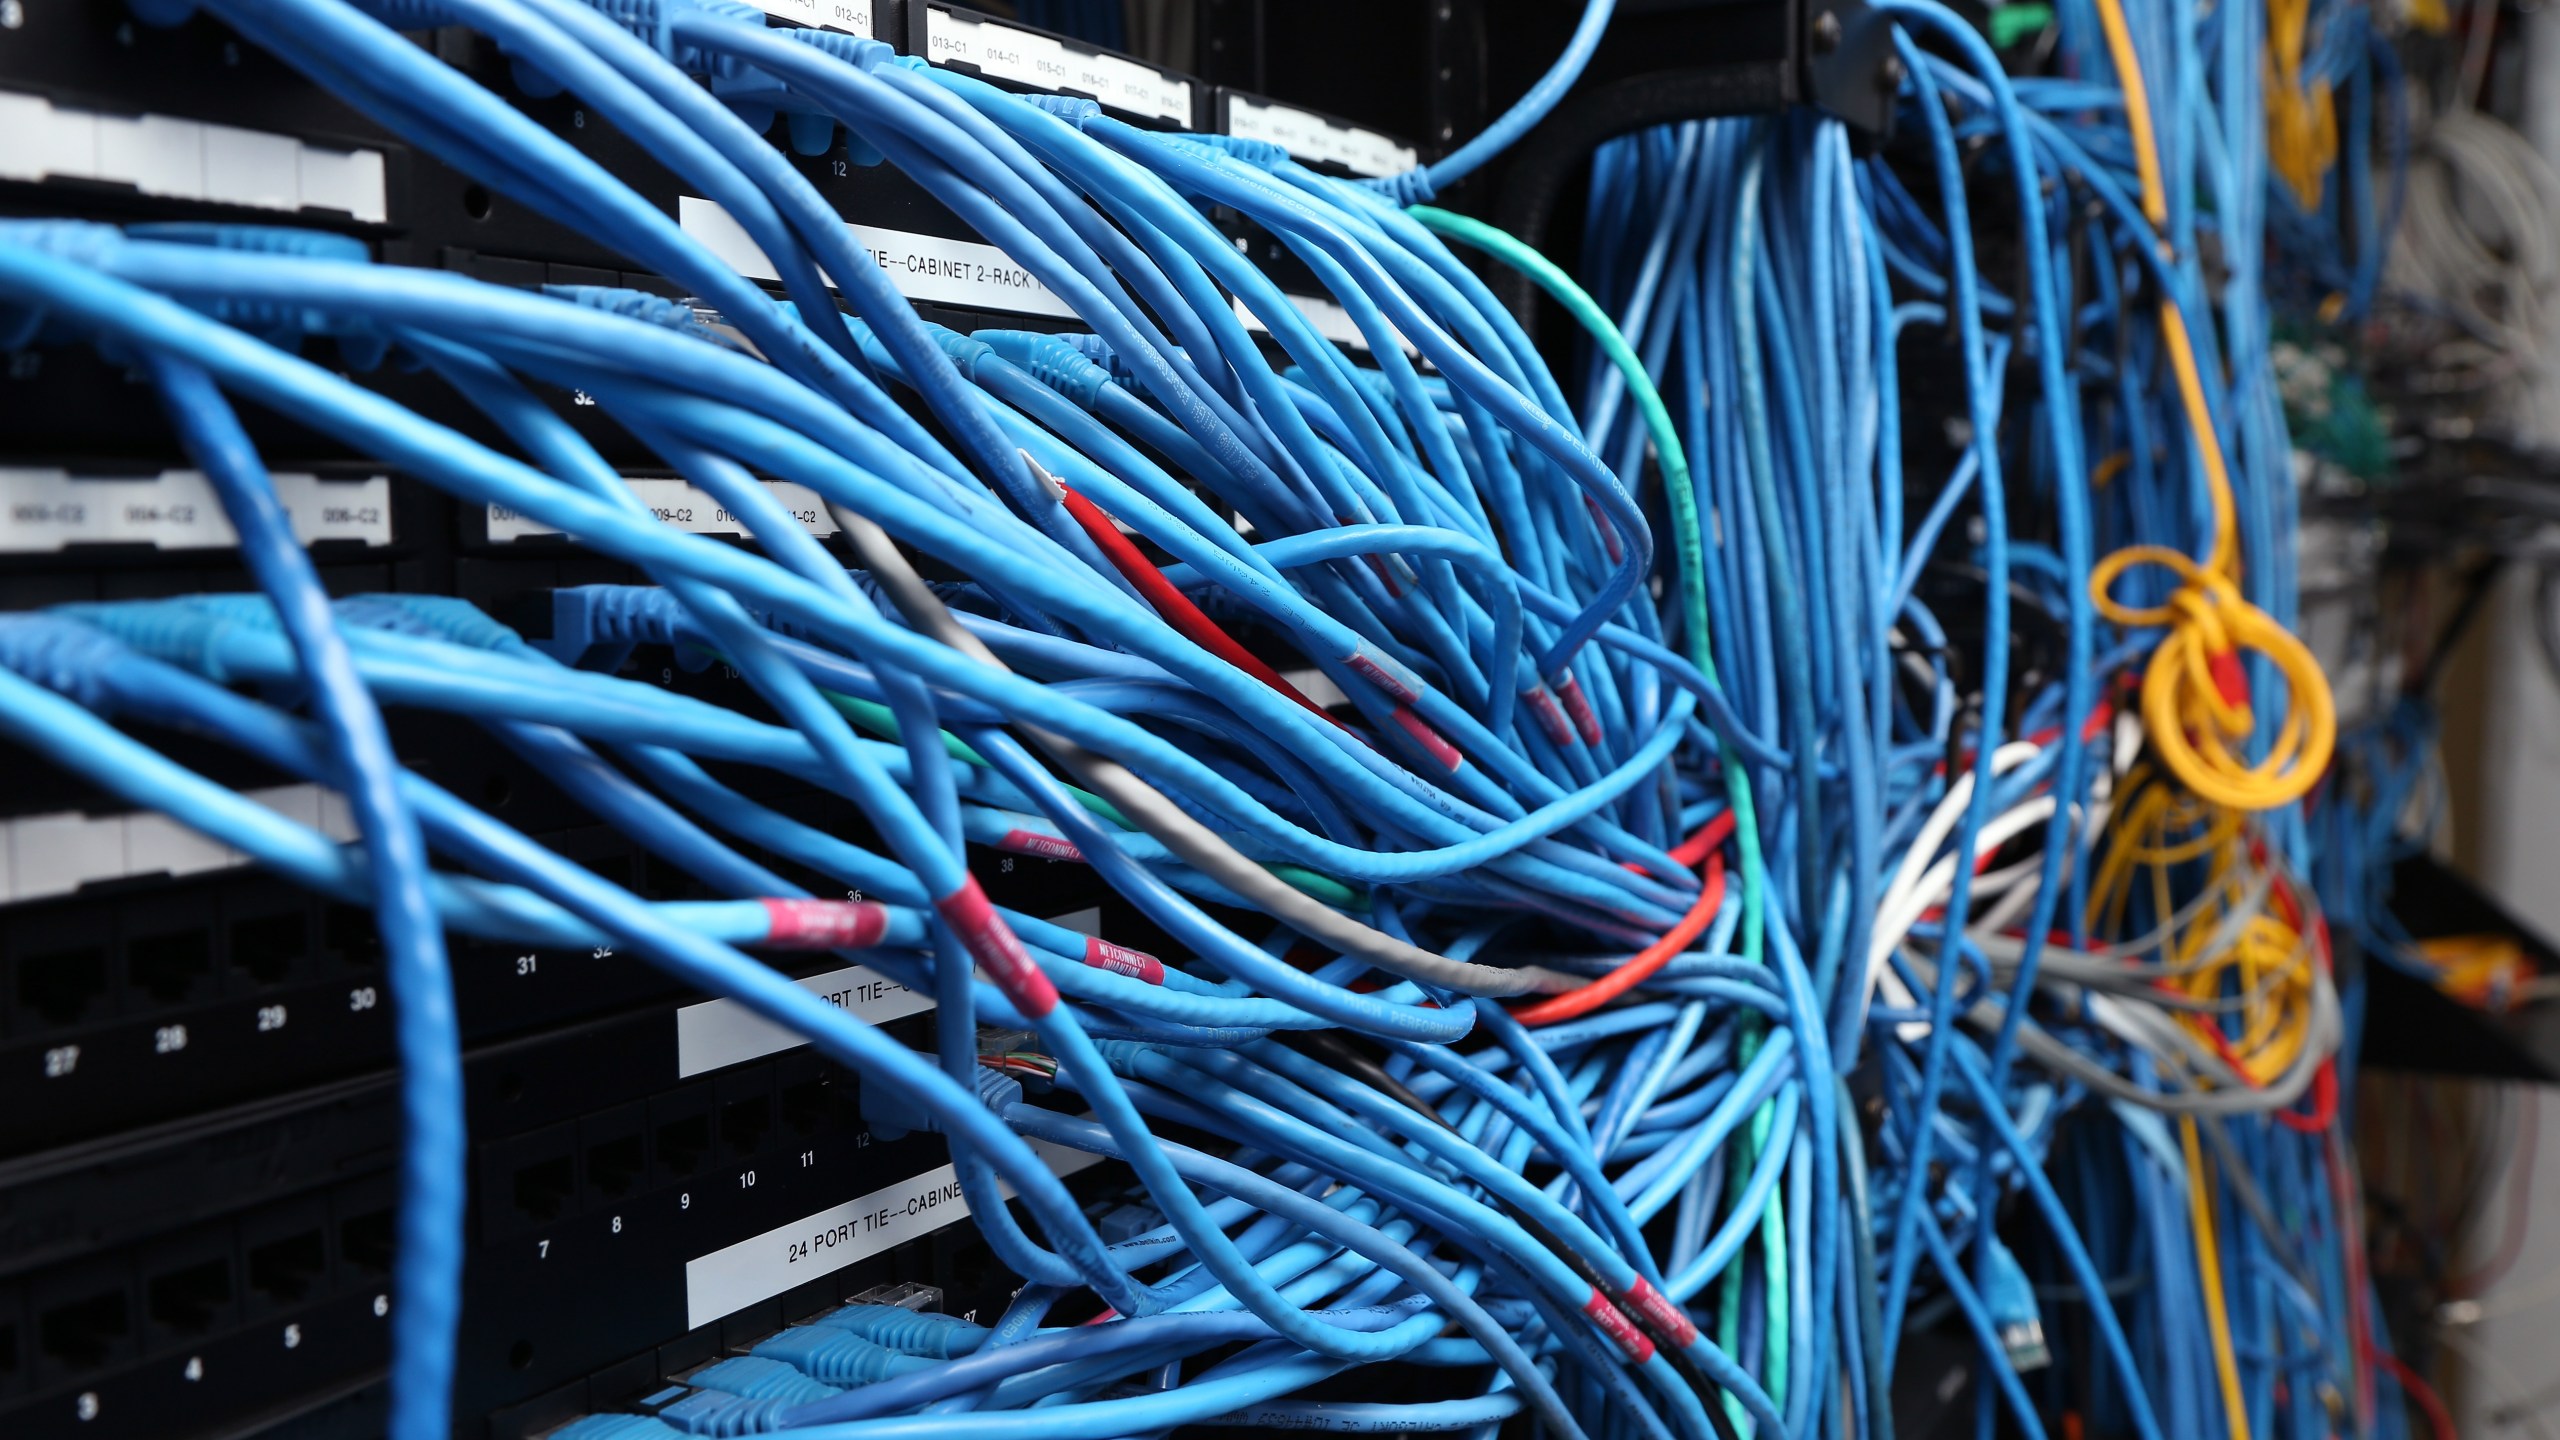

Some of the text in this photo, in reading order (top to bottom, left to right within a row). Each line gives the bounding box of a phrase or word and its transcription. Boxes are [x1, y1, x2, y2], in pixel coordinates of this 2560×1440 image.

[835, 6, 868, 26] 012-C1
[932, 36, 967, 54] 013-C1
[987, 48, 1020, 65] 014-C1
[1037, 60, 1066, 77] 015-C1
[574, 110, 584, 128] 8
[832, 160, 847, 177] 12
[977, 265, 1030, 289] 2-RACK
[1562, 430, 1607, 476] BELKIN
[789, 510, 816, 523] 1-C2
[662, 668, 672, 684] 9
[1024, 838, 1081, 859] NETCONNECT
[1001, 857, 1014, 873] 38
[847, 889, 862, 904] 36
[517, 954, 536, 975] 31
[1098, 943, 1147, 970] NETCONNECT
[1102, 958, 1141, 979] QUANTUM
[350, 987, 376, 1011] 30
[820, 990, 851, 1009] ORT
[1343, 989, 1382, 1018] HIGH
[257, 1005, 287, 1031] 29
[1207, 1028, 1239, 1041] CABLE
[856, 1132, 870, 1149] 12
[801, 1150, 814, 1168] 11
[739, 1171, 756, 1188] 10
[681, 1193, 690, 1209] 9
[612, 1216, 622, 1233] 8
[788, 1180, 962, 1263] 24 PORT TIE--CABINE
[538, 1240, 550, 1259] 7
[1122, 1235, 1177, 1247] www.belkin.com
[374, 1294, 388, 1317] 6
[964, 1309, 977, 1323] 37
[284, 1323, 300, 1348] 5
[184, 1356, 203, 1381] 4
[77, 1392, 98, 1421] 3
